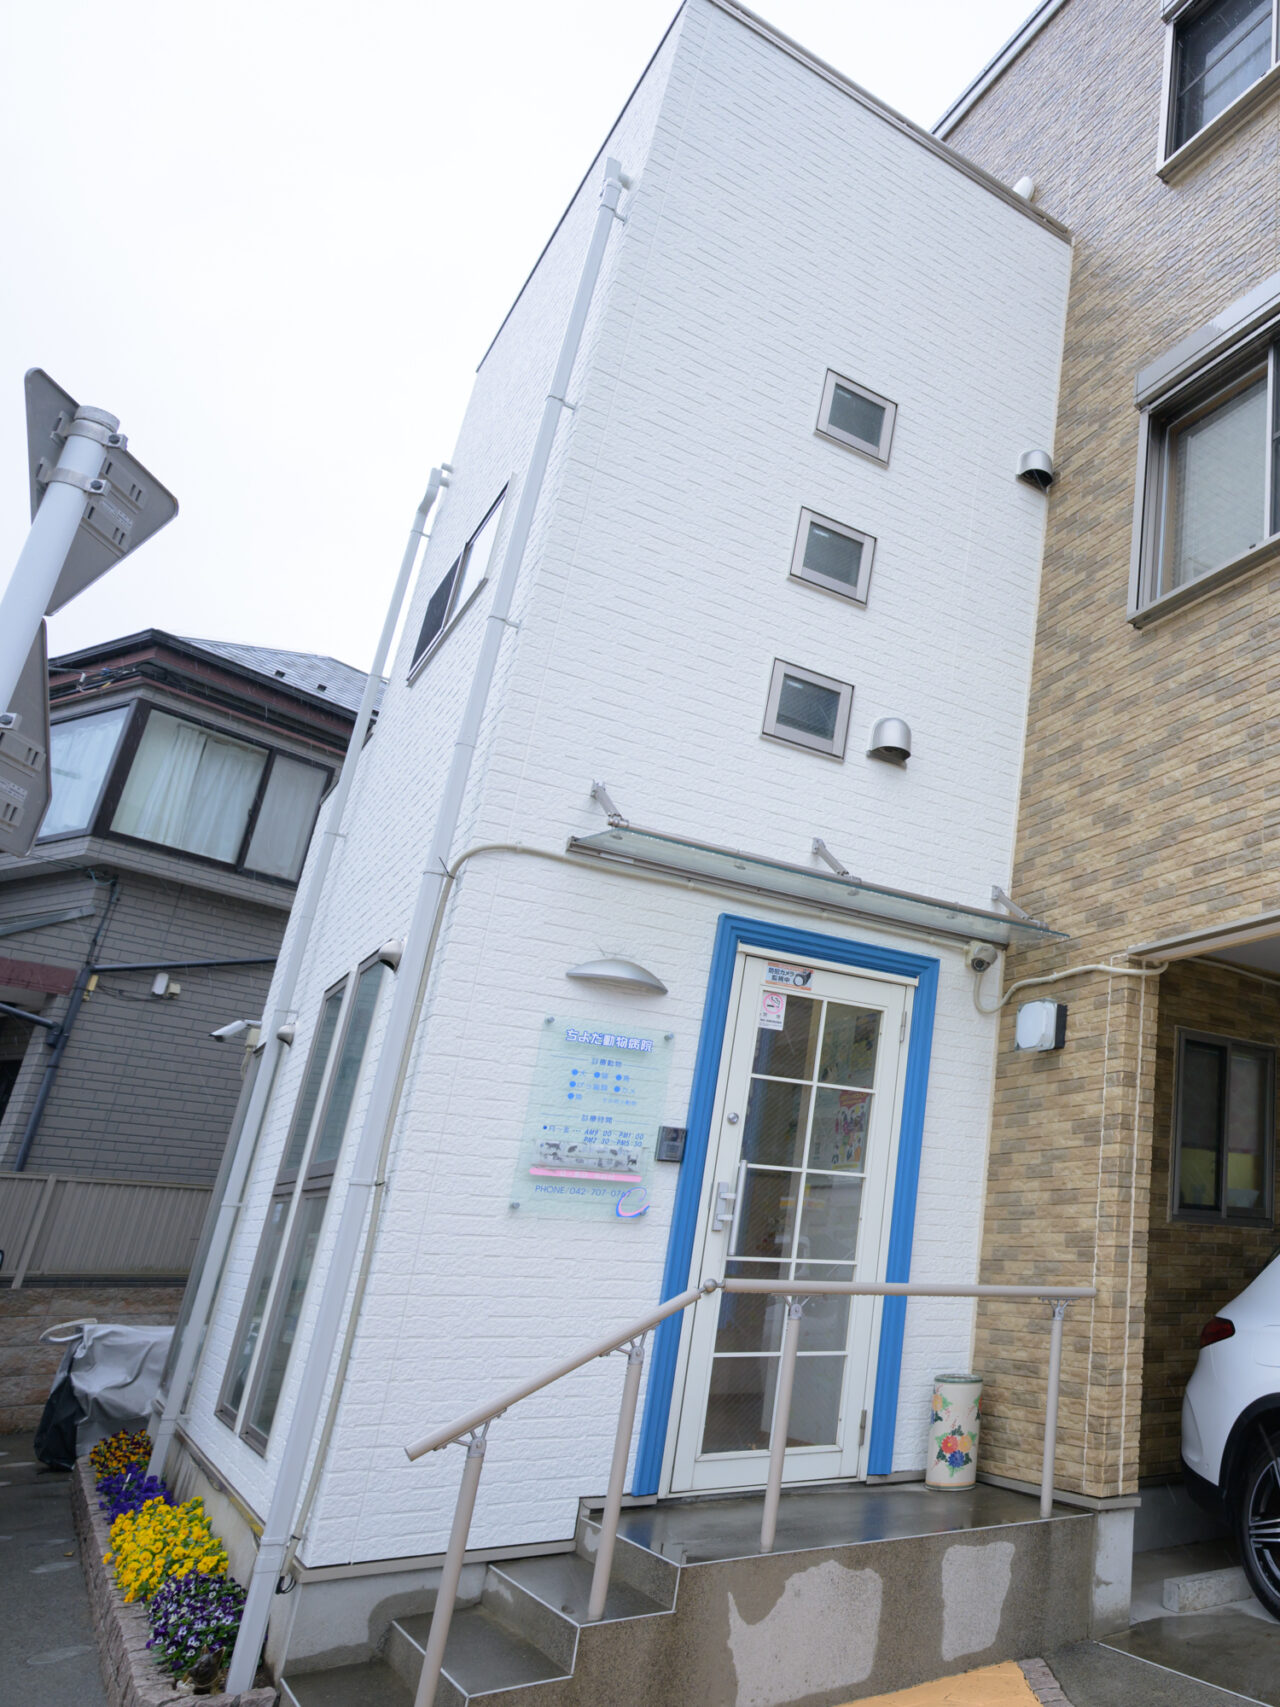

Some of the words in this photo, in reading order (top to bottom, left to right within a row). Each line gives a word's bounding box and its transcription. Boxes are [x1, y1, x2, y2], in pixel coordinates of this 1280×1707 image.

[565, 1028, 654, 1052] ちよだ動物病院
